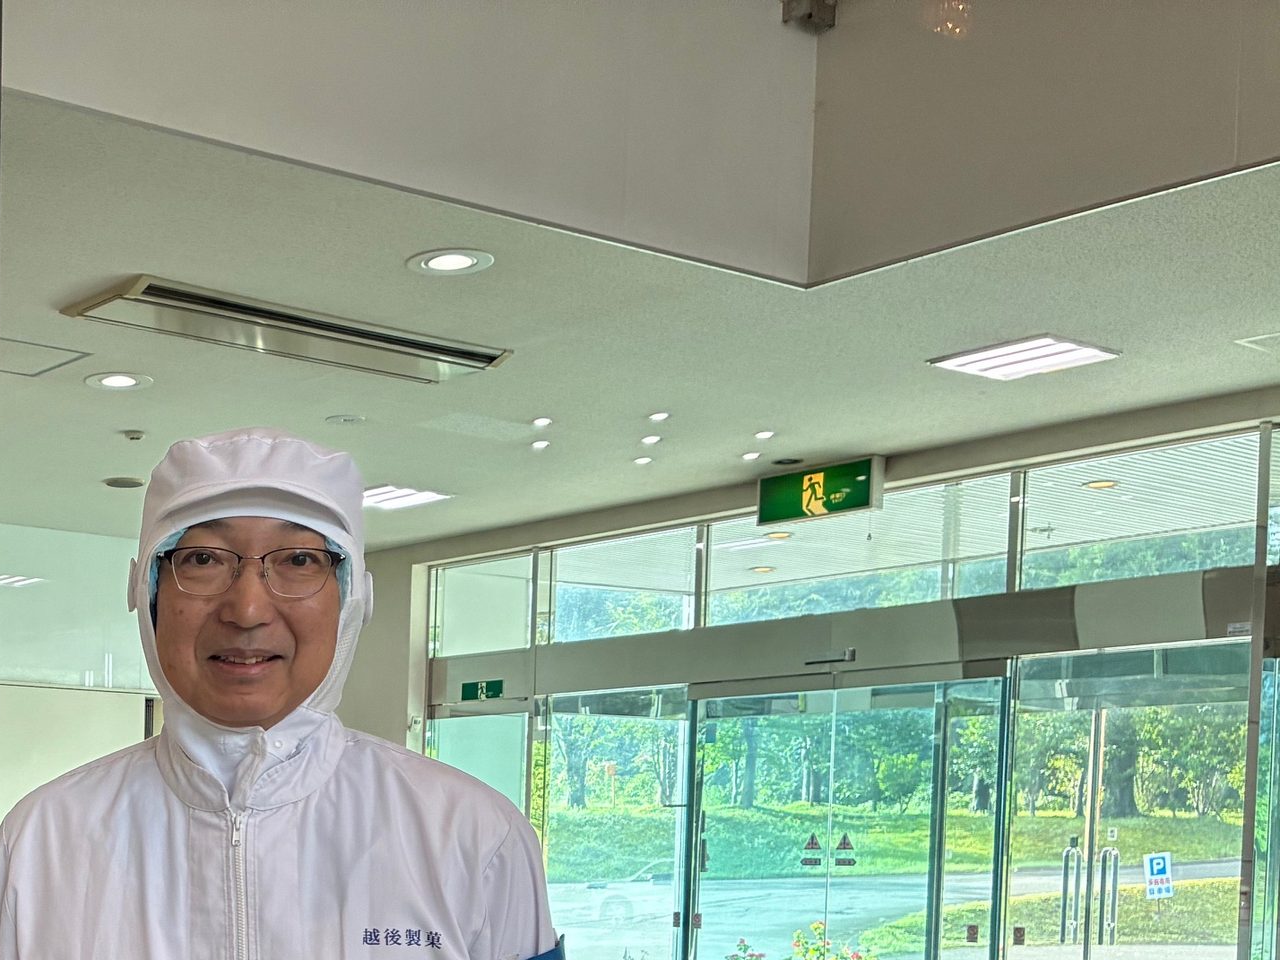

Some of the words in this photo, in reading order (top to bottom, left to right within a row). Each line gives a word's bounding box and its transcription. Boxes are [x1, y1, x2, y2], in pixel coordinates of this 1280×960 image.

[1152, 858, 1165, 875] P
[362, 928, 442, 950] 越後製菓
